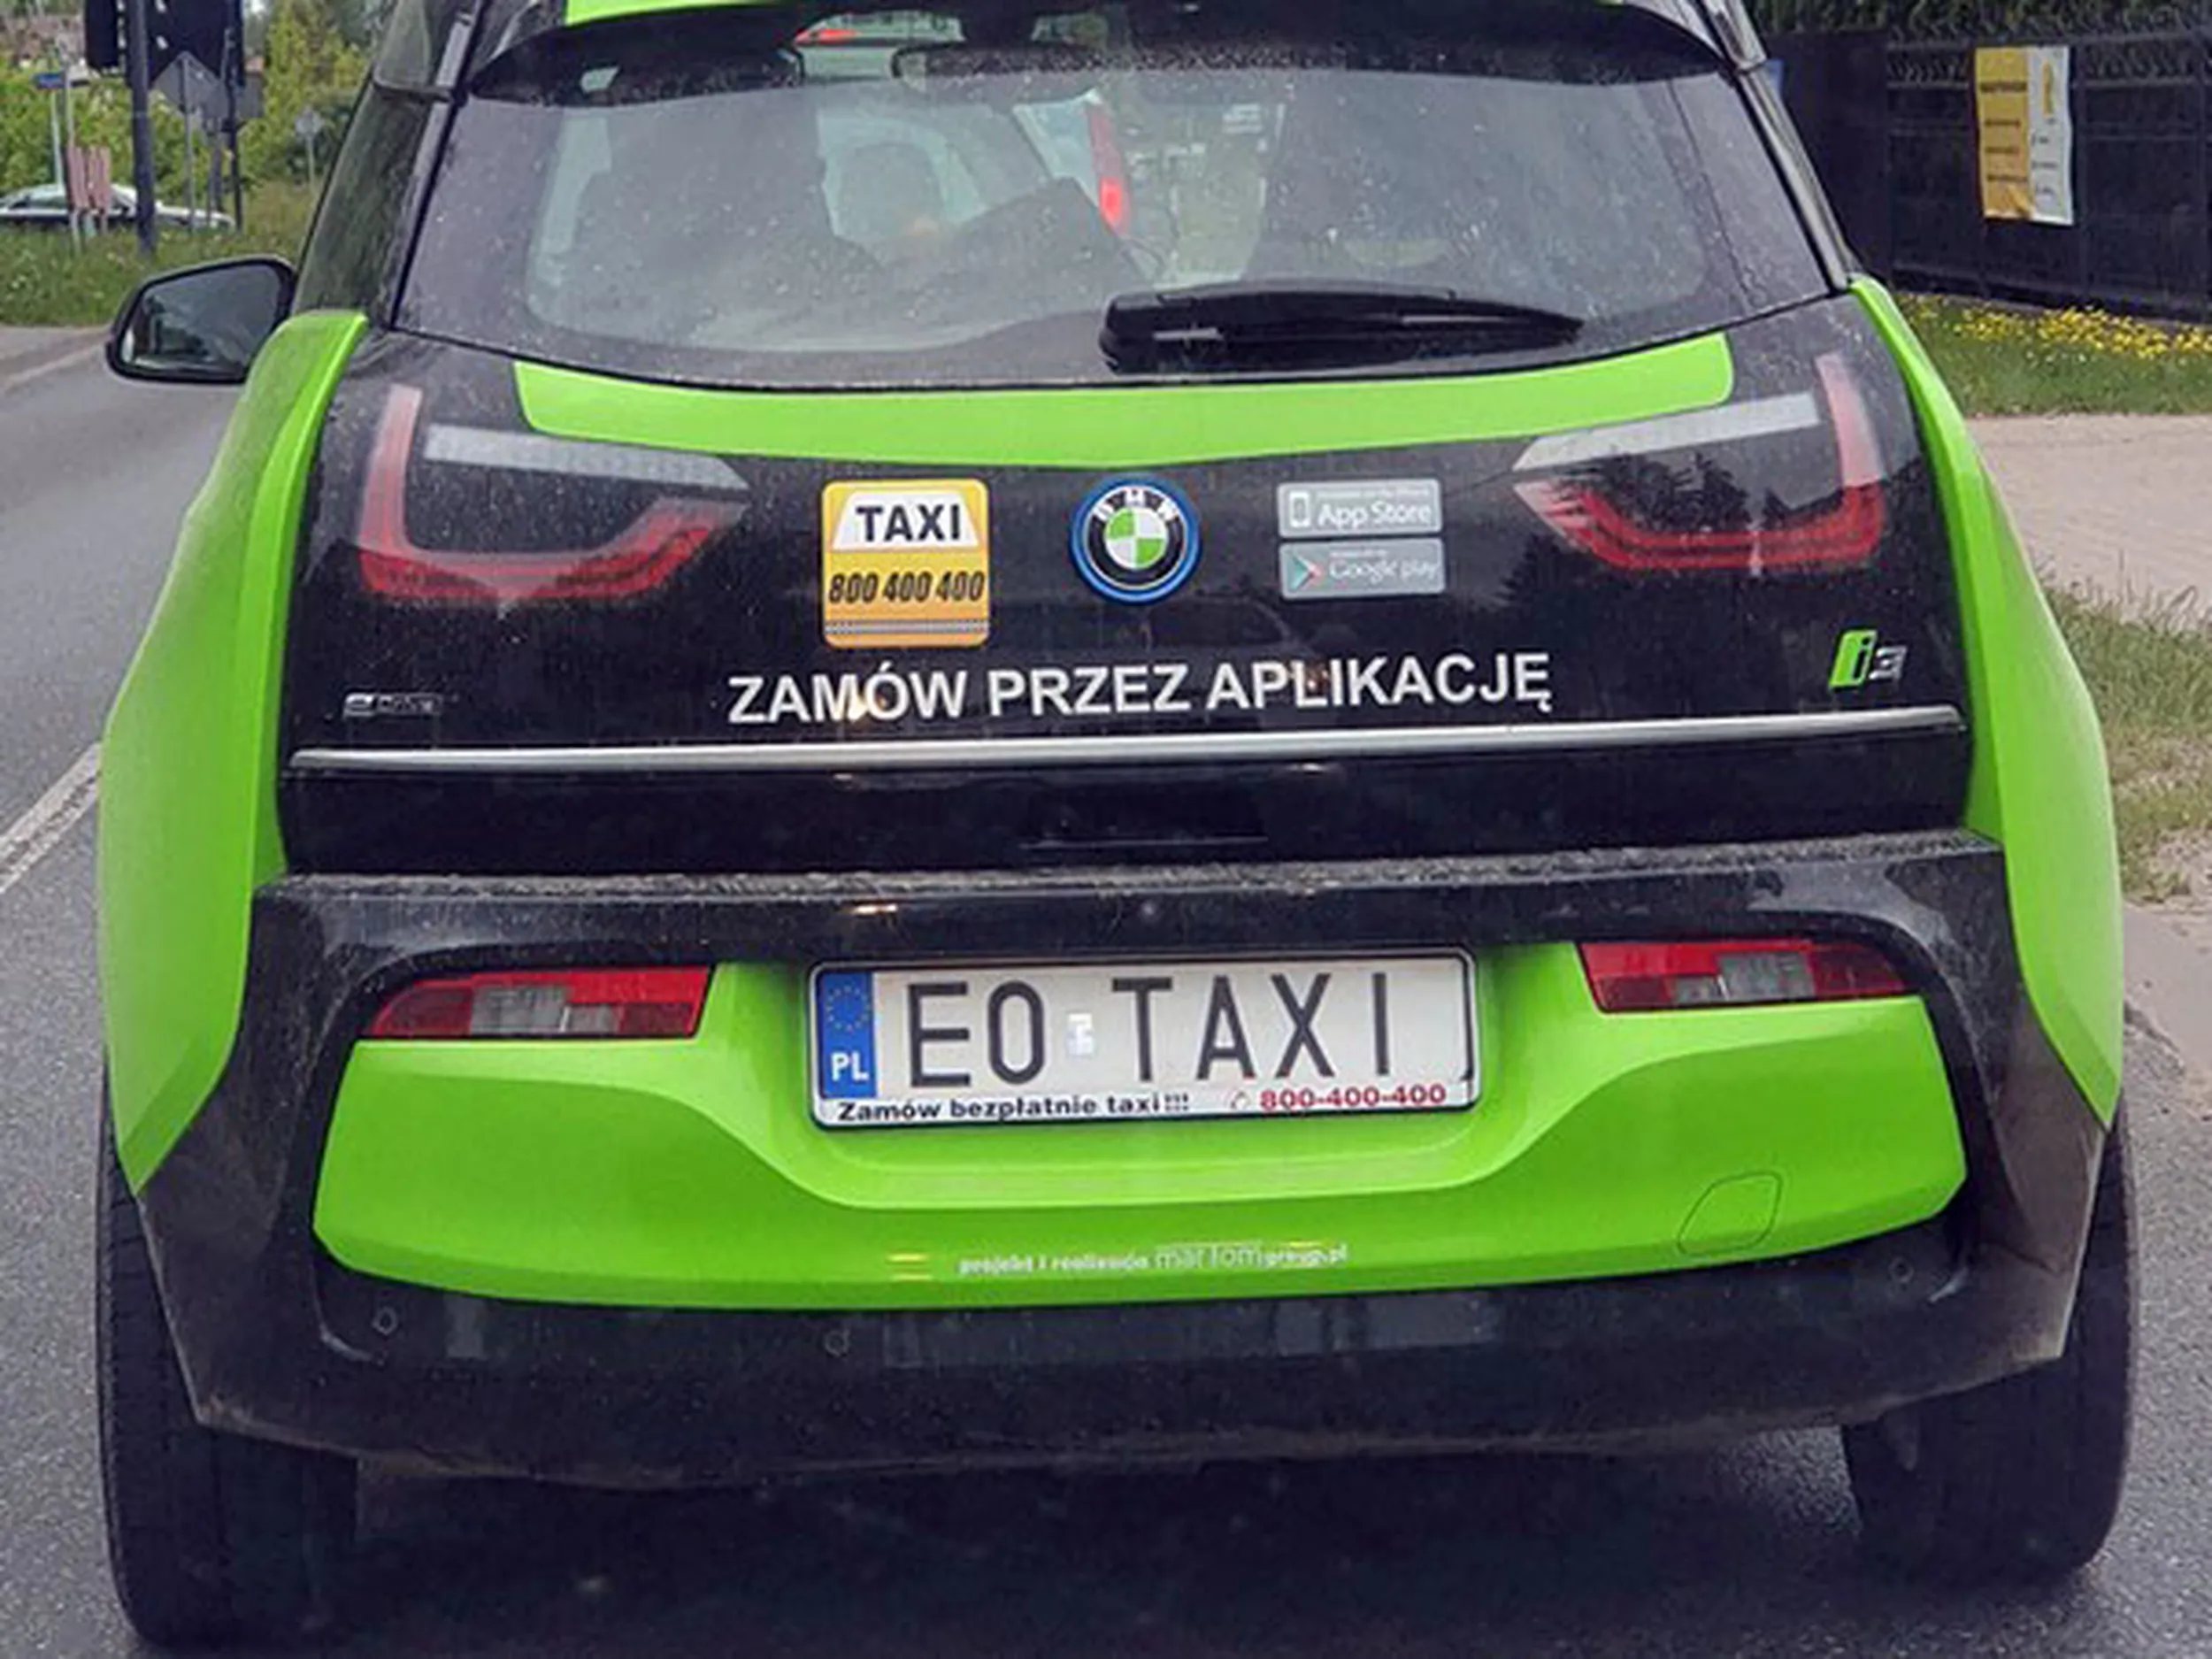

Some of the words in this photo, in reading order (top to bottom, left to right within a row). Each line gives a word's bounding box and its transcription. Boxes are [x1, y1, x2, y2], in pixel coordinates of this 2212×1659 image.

[856, 503, 960, 542] TAXI
[1318, 503, 1369, 532] App
[1371, 500, 1433, 526] Store
[828, 572, 879, 604] 800
[883, 571, 932, 603] 400
[936, 570, 986, 603] 400
[728, 661, 967, 724] ZAMÓW
[987, 664, 1191, 717] PRZEZ
[1206, 652, 1553, 713] APLIKACJĘ
[1111, 972, 1391, 1082] TAXI
[831, 1050, 869, 1081] PL
[838, 1097, 940, 1122] Zamów
[949, 1094, 1097, 1120] bezpłatnie
[1259, 1084, 1447, 1110] 800-400-400
